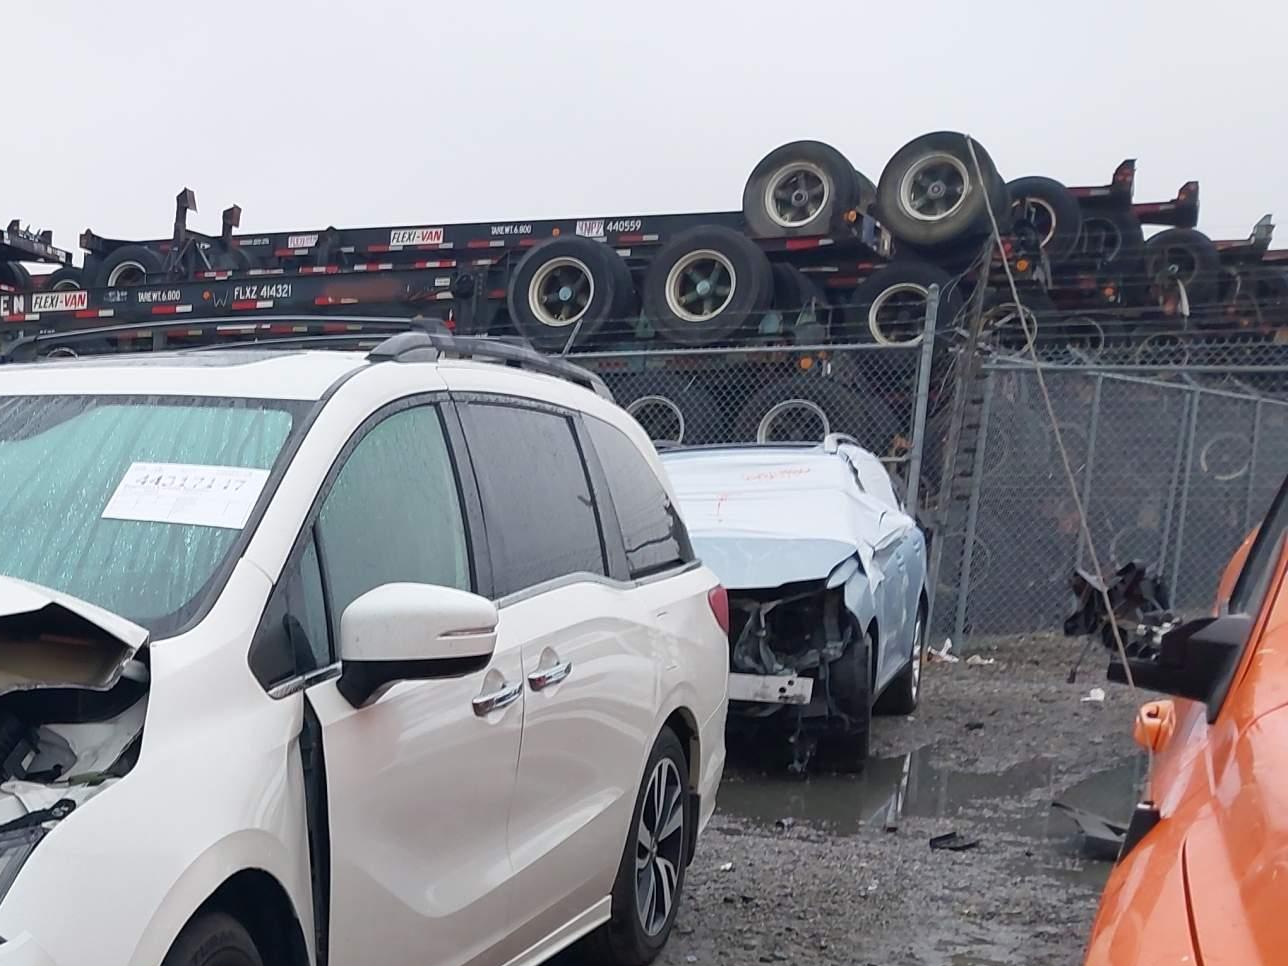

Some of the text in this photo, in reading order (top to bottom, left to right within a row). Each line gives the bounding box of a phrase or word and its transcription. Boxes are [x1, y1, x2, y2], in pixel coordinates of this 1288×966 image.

[606, 219, 642, 233] 440559
[391, 229, 443, 244] FLEXI-VAN
[234, 283, 293, 300] FLXZ 414321
[33, 293, 87, 311] FLEXI-VAN
